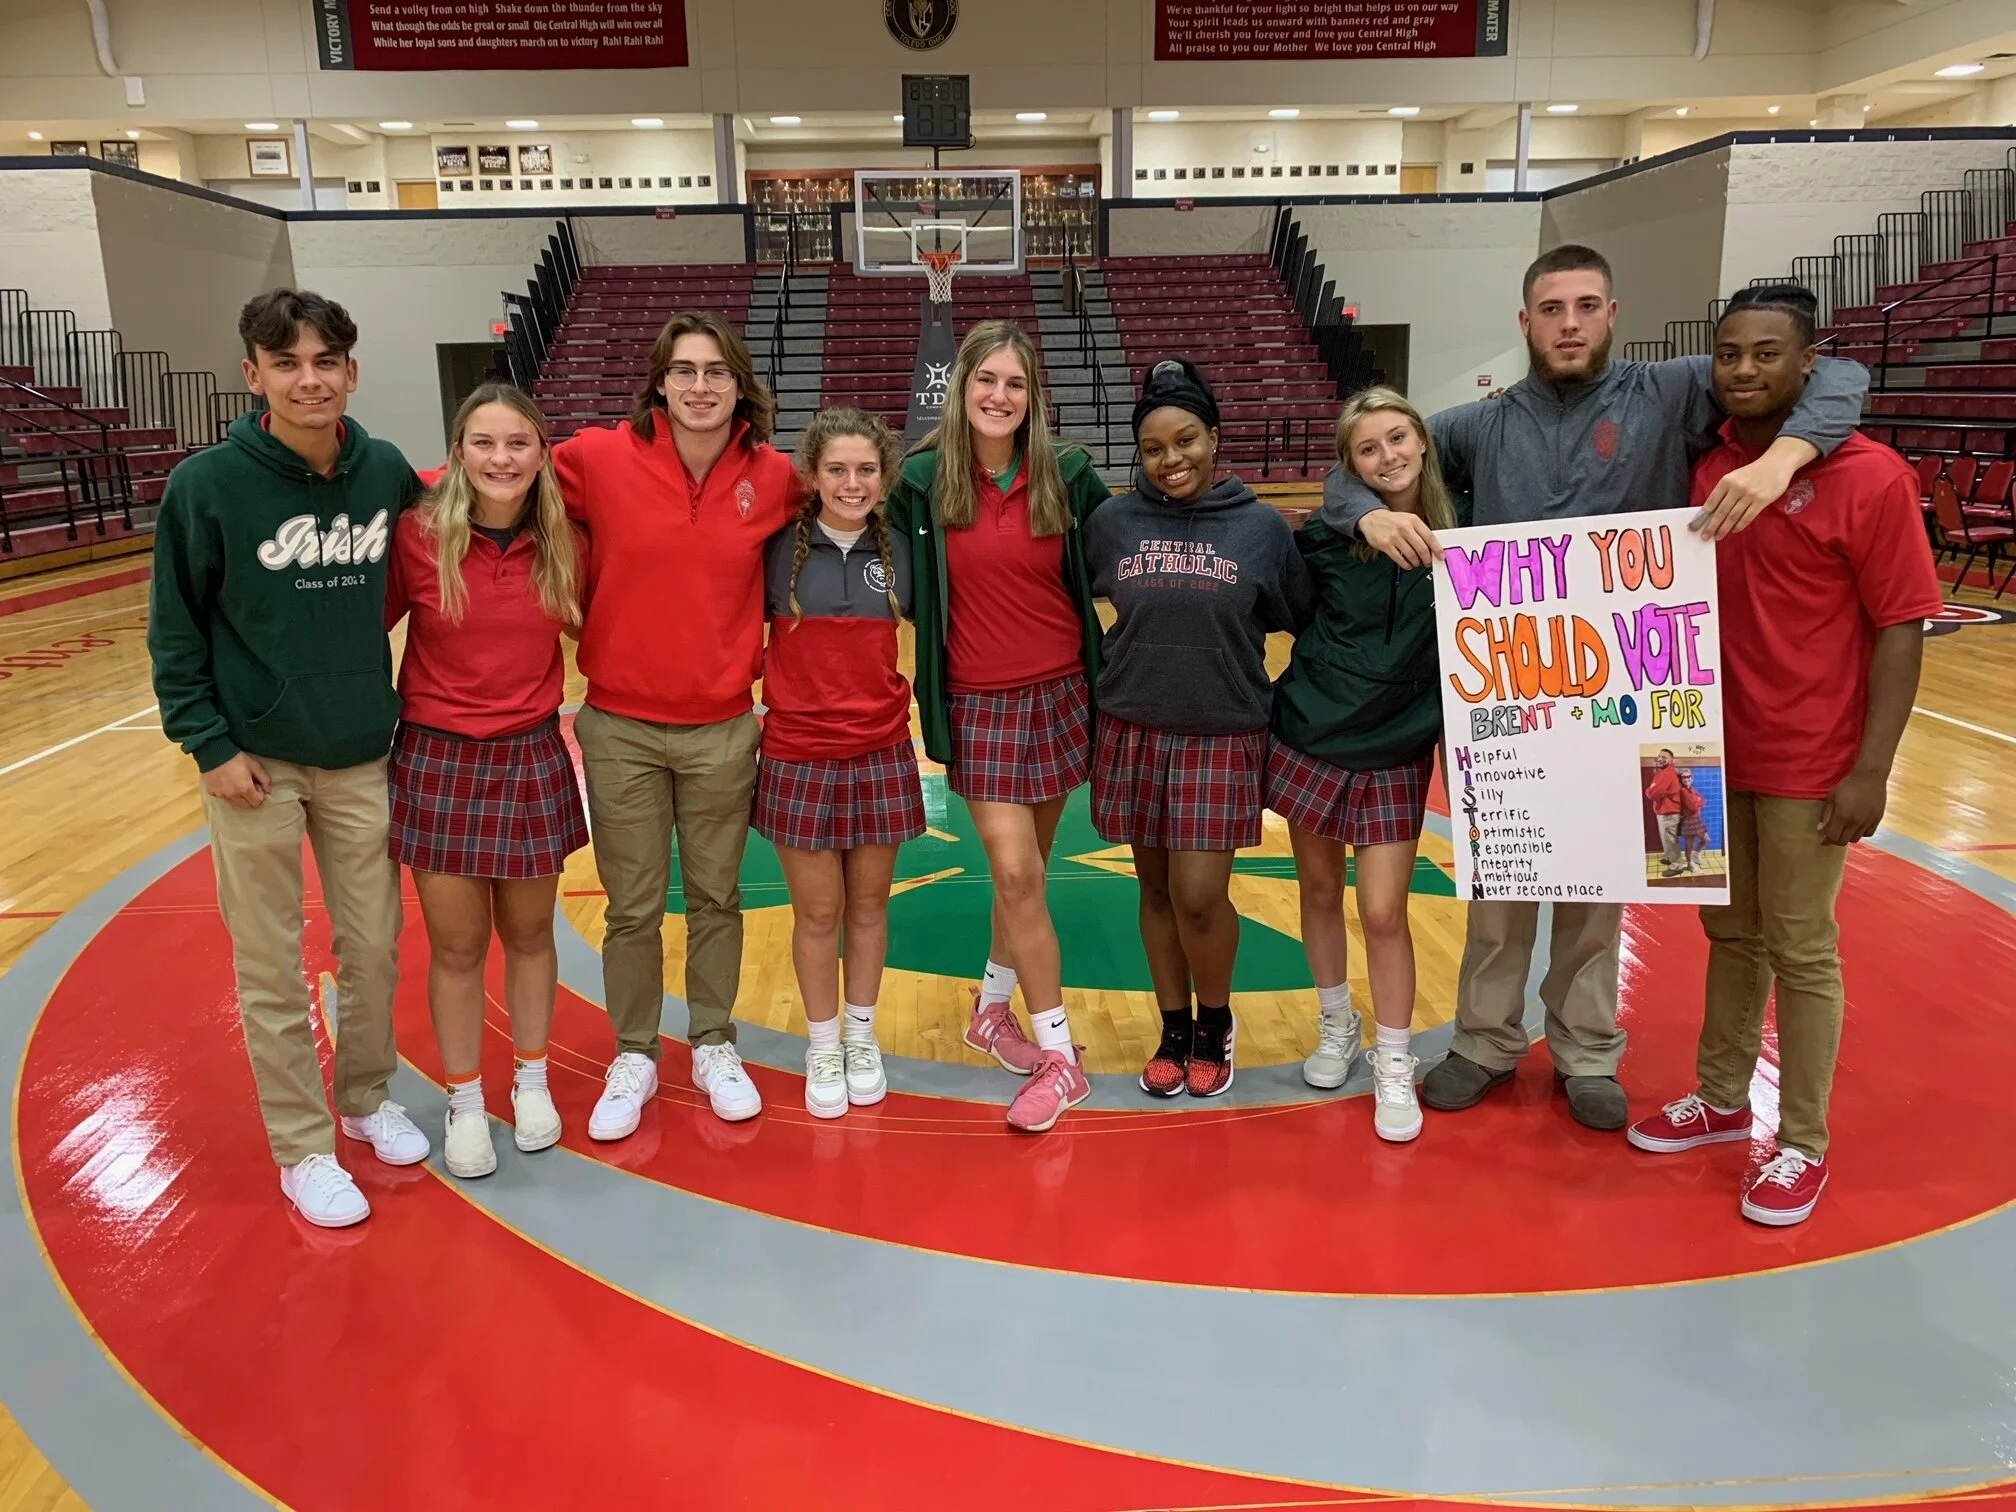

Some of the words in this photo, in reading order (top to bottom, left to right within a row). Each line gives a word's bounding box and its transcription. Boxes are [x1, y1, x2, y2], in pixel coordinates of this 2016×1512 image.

[369, 4, 392, 15] Send
[394, 6, 400, 14] a
[402, 5, 429, 17] volley
[431, 4, 453, 14] from
[455, 6, 466, 14] on
[469, 4, 489, 16] high
[495, 4, 522, 13] Shake
[524, 4, 549, 13] down
[552, 3, 566, 13] the
[569, 3, 604, 13] thunder
[607, 2, 628, 13] from
[631, 2, 645, 12] the
[648, 2, 663, 14] sky
[1166, 5, 1192, 15] We're
[1195, 4, 1233, 14] thankful
[1236, 4, 1249, 14] for
[1252, 5, 1272, 16] your
[1275, 4, 1297, 15] light
[1299, 5, 1309, 13] so
[1313, 3, 1342, 15] bright
[1344, 4, 1363, 13] that
[1366, 3, 1391, 13] helps
[1394, 4, 1405, 12] us
[1407, 4, 1419, 12] on
[1422, 3, 1438, 12] our
[1440, 3, 1459, 13] way
[371, 21, 394, 31] What
[396, 20, 425, 33] though
[426, 21, 440, 30] the
[441, 21, 460, 30] odds
[462, 20, 472, 30] be
[474, 21, 494, 32] great
[496, 22, 506, 30] or
[508, 20, 529, 31] small
[533, 20, 547, 30] Ole
[549, 19, 578, 30] Central
[579, 19, 598, 32] High
[600, 19, 615, 30] will
[617, 19, 632, 30] win
[633, 20, 651, 29] over
[653, 18, 663, 29] all
[1168, 18, 1189, 28] Your
[1193, 17, 1219, 29] spirit
[1223, 17, 1249, 27] leads
[1252, 18, 1263, 26] us
[1266, 17, 1303, 26] onward
[1306, 17, 1327, 26] with
[1331, 16, 1370, 26] banners
[1373, 15, 1389, 25] red
[1392, 15, 1410, 25] and
[1413, 16, 1435, 27] gray
[1486, 0, 1499, 42] MATER
[326, 13, 343, 64] VICTORY
[1168, 30, 1192, 40] We'll
[1195, 29, 1231, 39] cherish
[1234, 31, 1251, 41] you
[1254, 29, 1290, 39] forever
[1293, 29, 1311, 38] and
[1314, 29, 1334, 38] love
[1337, 30, 1355, 41] you
[1358, 28, 1392, 38] Central
[1396, 28, 1418, 39] High
[373, 37, 397, 48] While
[399, 37, 413, 48] her
[416, 37, 435, 50] loyal
[437, 38, 456, 47] sons
[458, 37, 474, 47] and
[475, 37, 518, 50] daughters
[520, 36, 546, 47] march
[547, 38, 558, 47] on
[560, 37, 569, 46] to
[571, 36, 598, 48] victory
[1169, 43, 1182, 53] All
[1186, 43, 1215, 55] praise
[1219, 43, 1229, 52] to
[1232, 44, 1250, 55] you
[1253, 44, 1270, 52] our
[1273, 42, 1308, 52] Mother
[1315, 42, 1329, 52] We
[1332, 42, 1353, 51] love
[1356, 43, 1373, 53] you
[1376, 41, 1410, 51] Central
[1414, 40, 1436, 52] High
[916, 392, 945, 405] TD
[257, 508, 388, 571] Irish
[1140, 540, 1215, 555] CENTRAL
[1118, 553, 1238, 584] CATHOLIC
[1444, 534, 1572, 610] WHY
[1588, 524, 1674, 593] YOU
[295, 578, 324, 589] Class
[327, 576, 339, 588] of
[1132, 578, 1163, 589] CLASS
[1170, 579, 1184, 589] OF
[1449, 613, 1610, 703] SHOULD
[1612, 601, 1714, 691] VOTE
[1470, 701, 1556, 742] BRENT
[1571, 706, 1583, 720] +
[1591, 694, 1638, 728] MO
[1650, 689, 1706, 730] FOR
[1464, 767, 1546, 786] Innovative
[1461, 785, 1503, 808] Silly
[1469, 825, 1545, 842] Optimistic
[1470, 840, 1553, 857] Responsible
[1473, 857, 1533, 872] Integrity
[1472, 870, 1538, 883] Ambitious
[1472, 883, 1511, 900] Never
[1516, 884, 1563, 897] second
[1567, 885, 1603, 897] place
